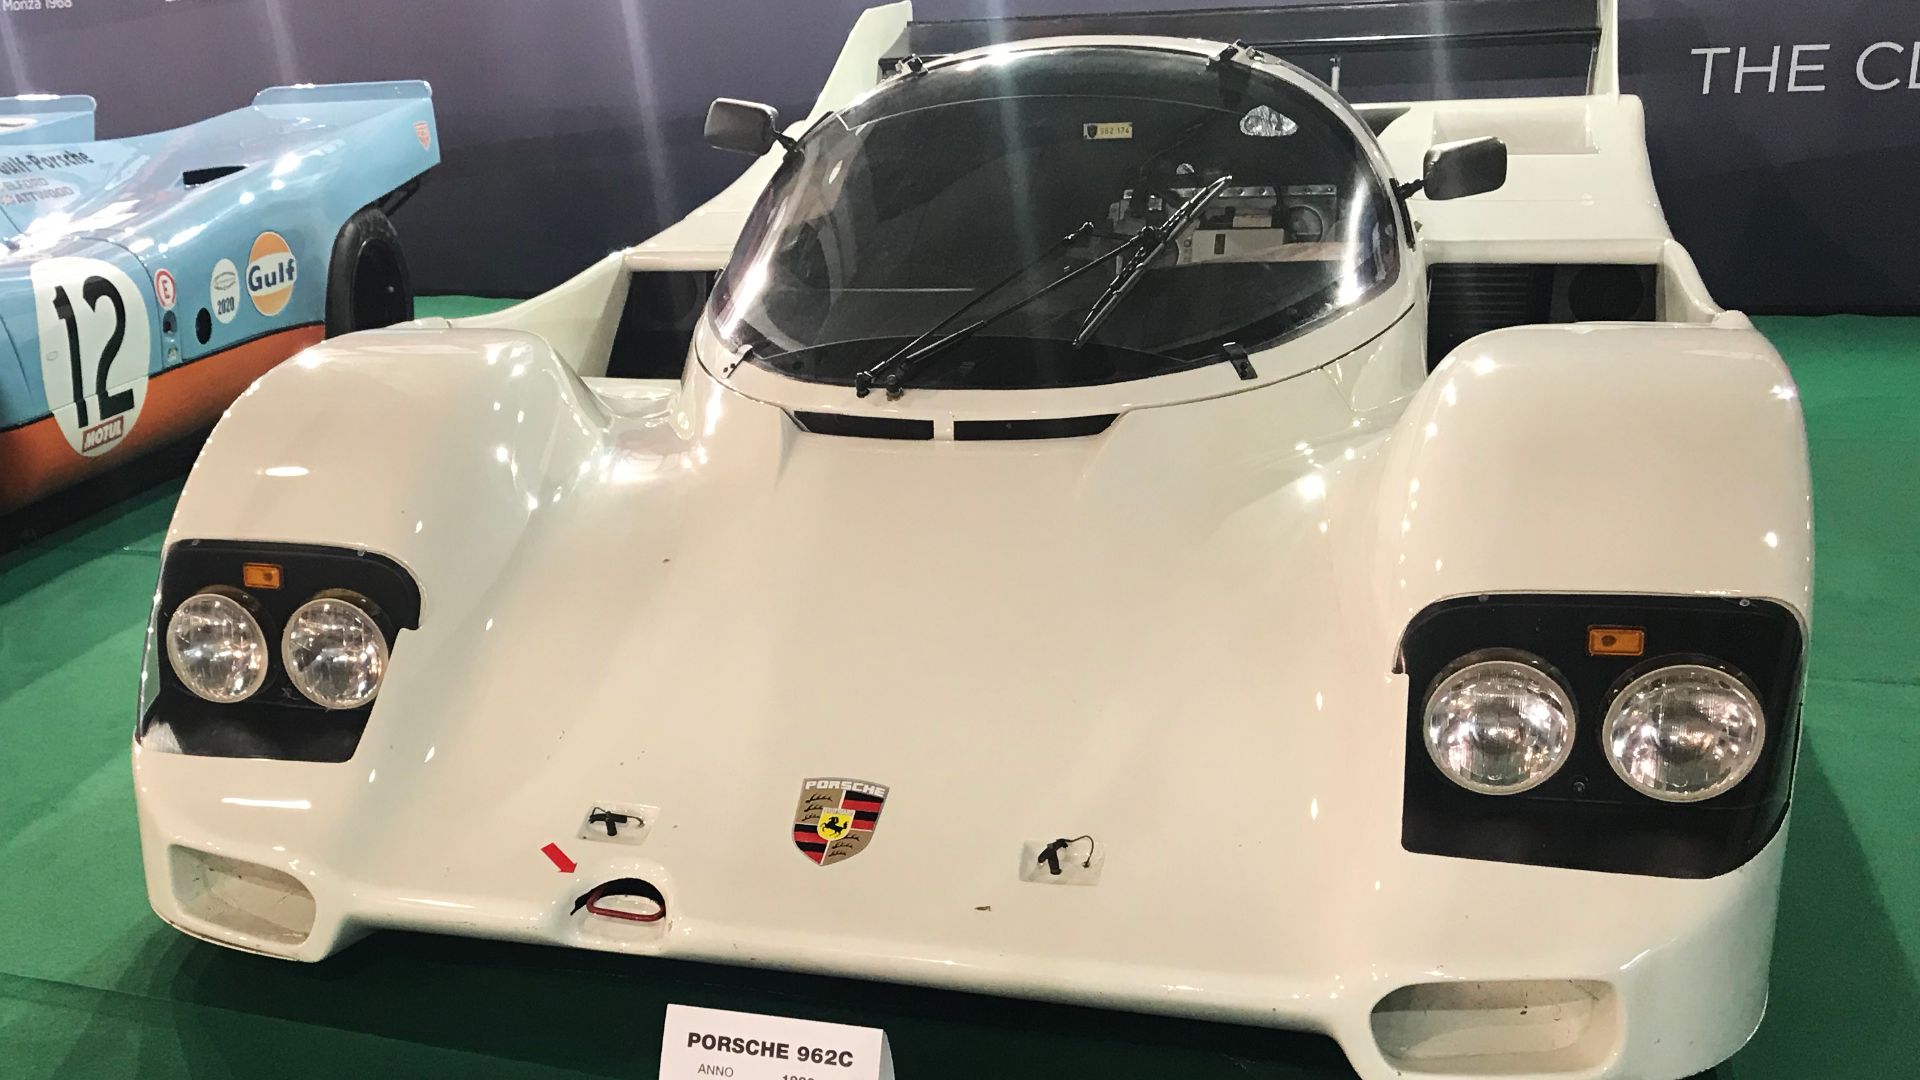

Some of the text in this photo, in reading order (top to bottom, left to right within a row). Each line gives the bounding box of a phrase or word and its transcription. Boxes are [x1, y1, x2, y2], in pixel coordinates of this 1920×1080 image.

[3, 0, 73, 11] Monza 1968
[1691, 43, 1831, 94] THE
[248, 259, 295, 291] Gulf
[161, 279, 171, 300] E
[217, 296, 235, 315] 2020
[53, 275, 135, 428] 12
[85, 419, 122, 449] MOTUL
[805, 780, 886, 797] PORSCHE
[687, 1032, 854, 1067] PORSCHE 962C
[697, 1063, 734, 1078] ANNO
